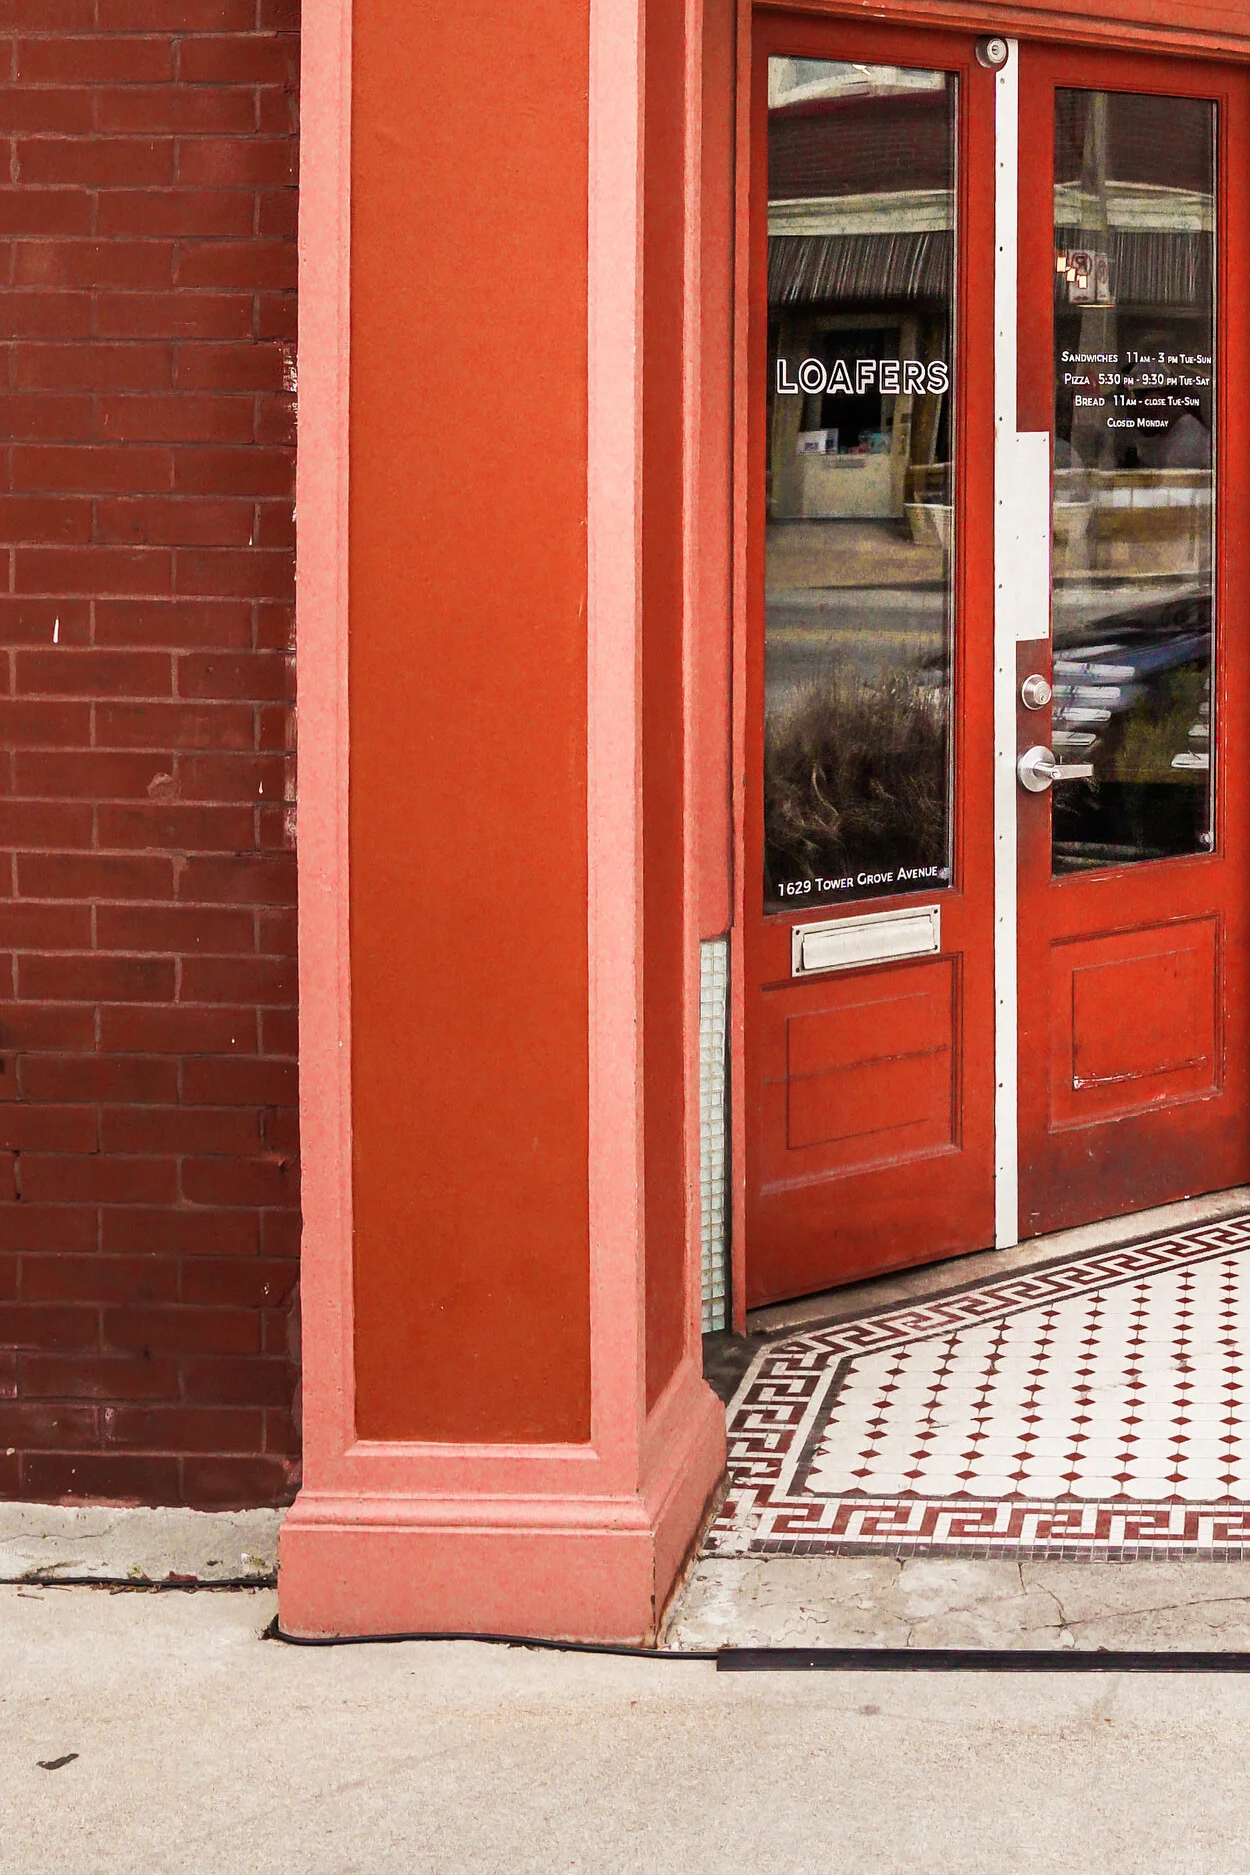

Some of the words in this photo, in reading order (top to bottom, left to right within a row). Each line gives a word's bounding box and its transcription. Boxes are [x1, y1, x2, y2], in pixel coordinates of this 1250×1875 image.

[1061, 351, 1118, 363] SANDWICHES
[1158, 352, 1165, 363] 3
[1167, 356, 1178, 364] PM
[776, 358, 949, 394] LOAFERS
[1064, 373, 1090, 385] PIZZA
[1098, 374, 1121, 385] 5:30
[1123, 377, 1134, 385] PM
[1142, 373, 1165, 385] 9:30
[1166, 377, 1178, 386] PM
[1075, 395, 1105, 406] BREAD
[1107, 417, 1135, 428] CLOSED
[1137, 418, 1169, 428] MONDAY
[778, 880, 812, 897] 1629
[815, 877, 854, 892] TOWER
[857, 872, 893, 885] GROVE
[897, 866, 938, 881] AVENUE
